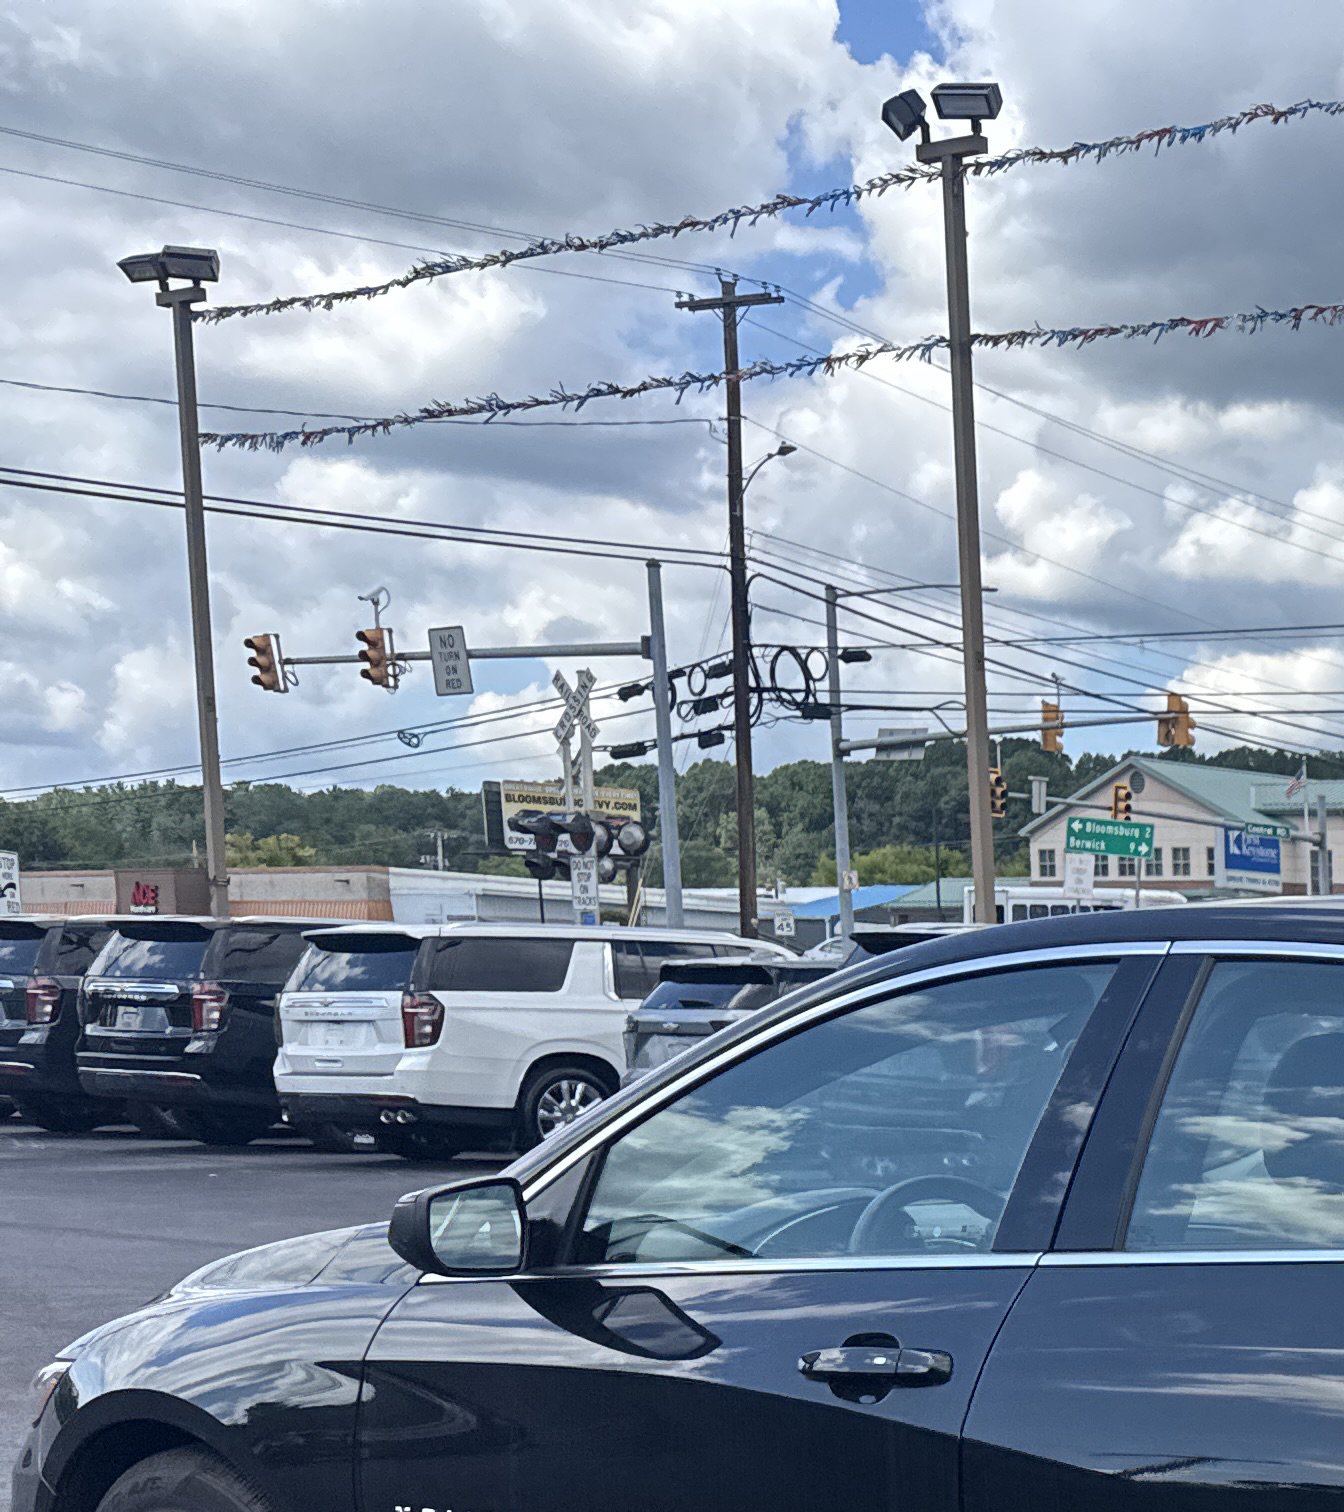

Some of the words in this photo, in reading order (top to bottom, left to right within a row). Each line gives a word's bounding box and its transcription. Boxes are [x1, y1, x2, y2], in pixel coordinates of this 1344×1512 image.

[439, 634, 454, 649] NO
[439, 651, 461, 662] TURN
[445, 664, 458, 676] ON
[445, 678, 462, 689] RED
[555, 671, 595, 740] CROSSING
[1085, 821, 1140, 838] Bloomsburg
[1144, 826, 1152, 838] 2
[1069, 836, 1106, 850] Berwick
[1129, 842, 1136, 853] 9
[776, 922, 792, 933] 45
